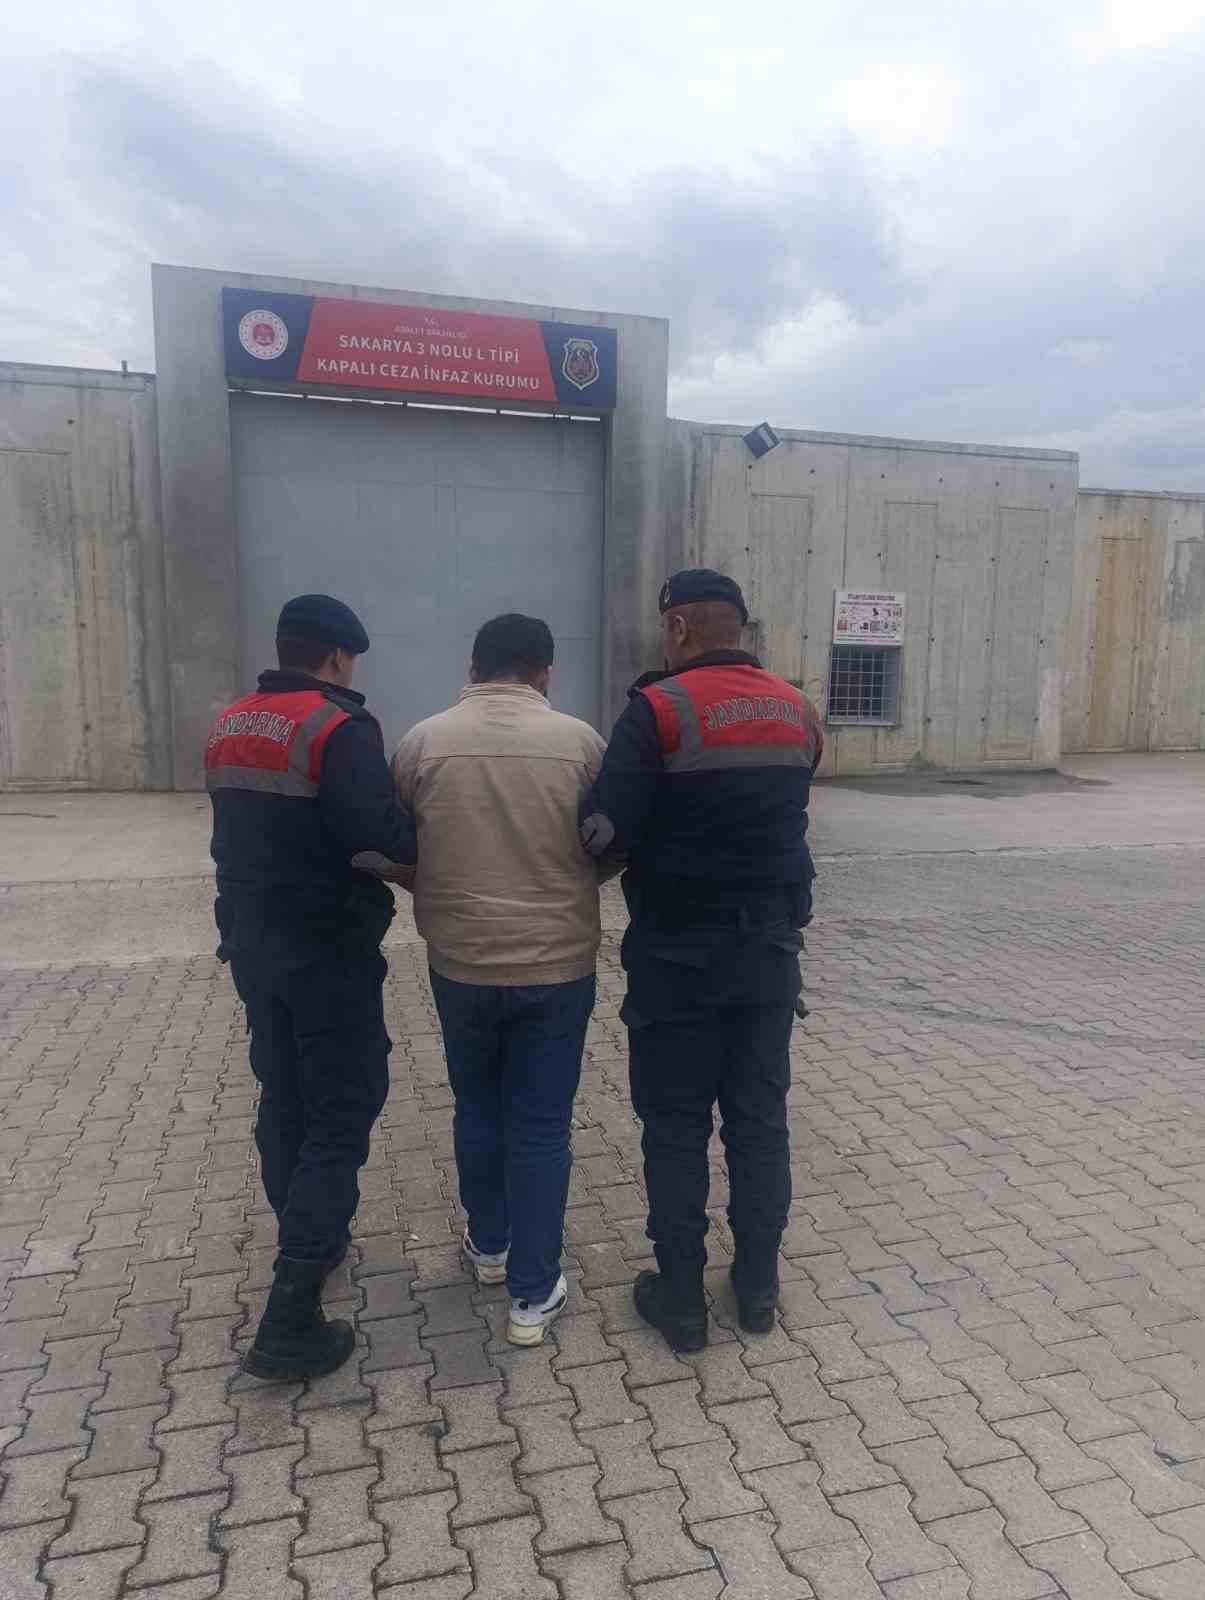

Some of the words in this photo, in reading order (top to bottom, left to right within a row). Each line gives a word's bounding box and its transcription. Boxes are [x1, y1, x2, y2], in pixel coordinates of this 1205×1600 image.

[339, 335, 412, 354] SAKARYA
[417, 343, 425, 355] 3
[430, 343, 472, 360] NOLU
[477, 348, 485, 361] L
[489, 346, 519, 364] TİPİ
[317, 358, 375, 375] KAPALI
[380, 363, 420, 380] CEZA
[424, 364, 469, 383] İNFAZ
[473, 370, 540, 390] KURUMU
